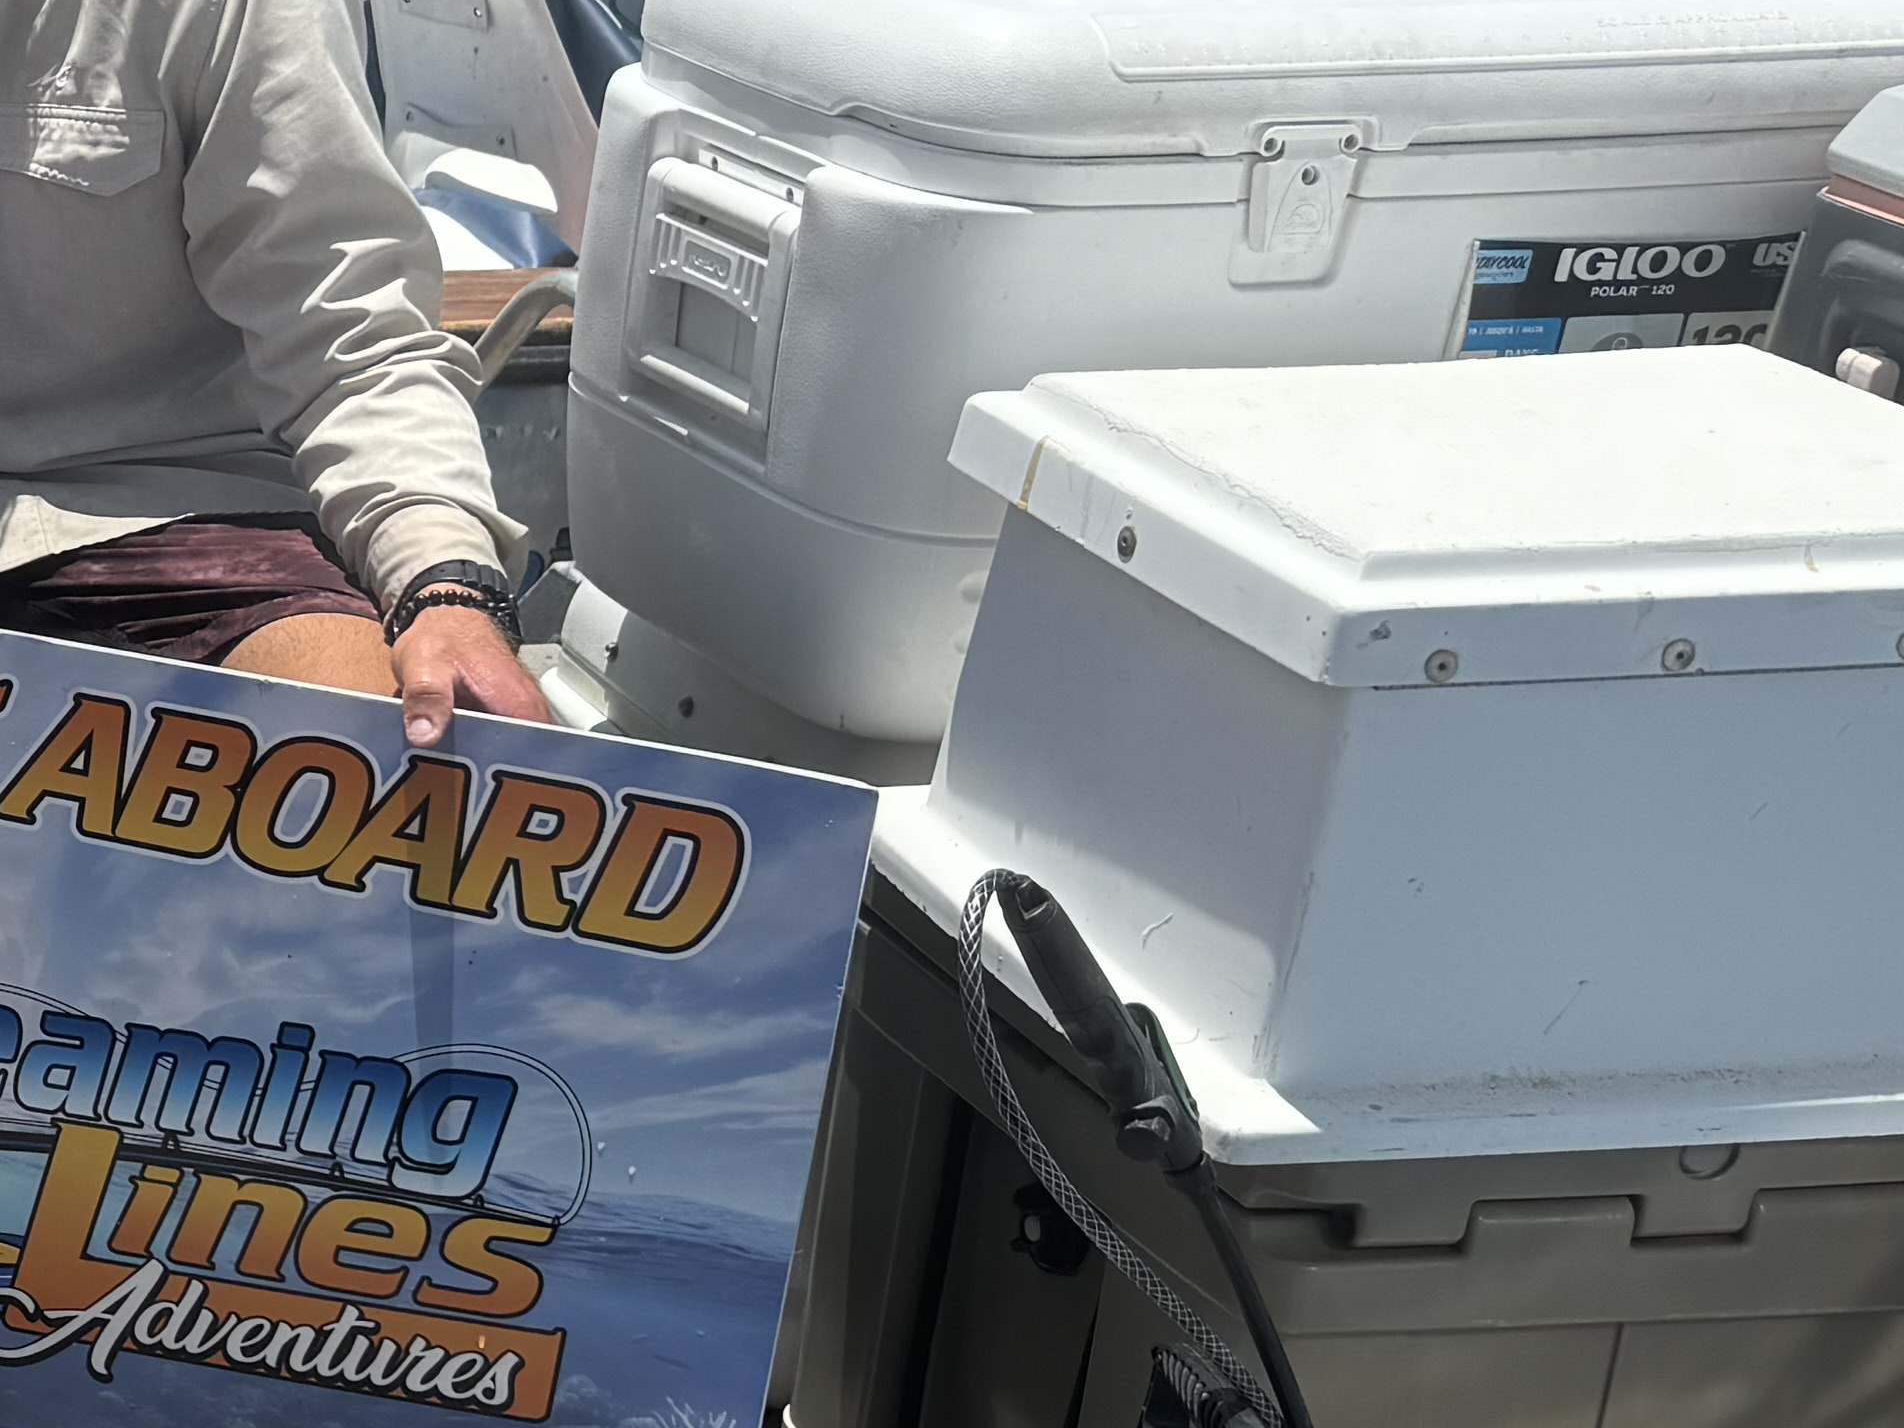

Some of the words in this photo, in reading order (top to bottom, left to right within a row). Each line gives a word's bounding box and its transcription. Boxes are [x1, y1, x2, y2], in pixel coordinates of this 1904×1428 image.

[1554, 243, 1727, 283] IGLOO
[1752, 240, 1798, 267] US
[1589, 285, 1638, 298] POLAR
[1651, 283, 1676, 296] 120
[7, 1119, 560, 1330] Lines
